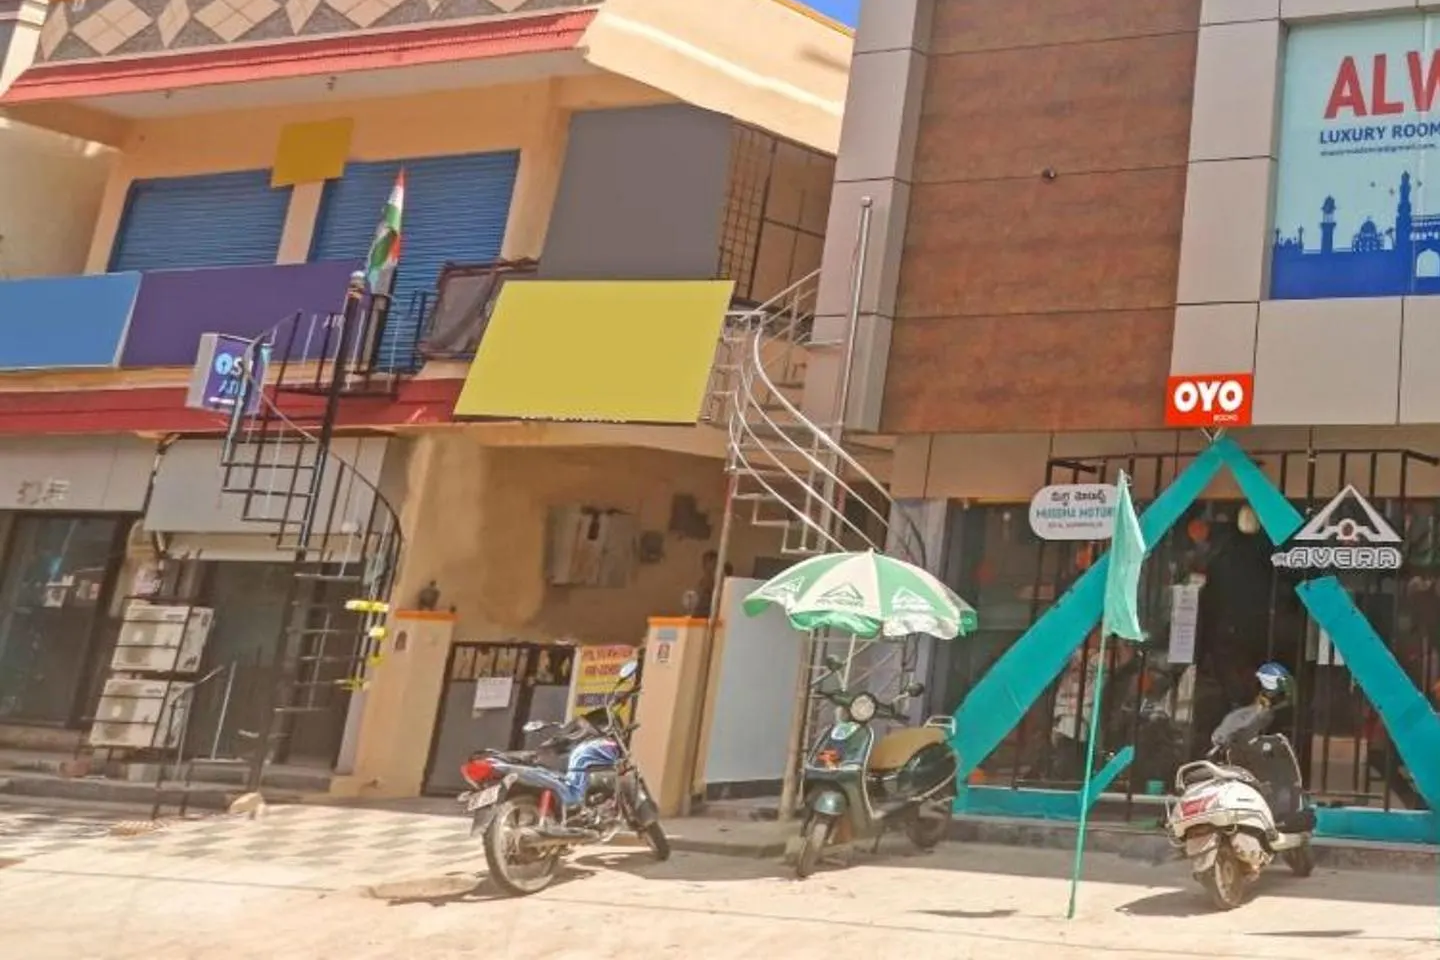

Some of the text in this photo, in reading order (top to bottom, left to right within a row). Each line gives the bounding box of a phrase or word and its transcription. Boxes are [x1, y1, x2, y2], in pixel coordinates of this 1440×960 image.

[1320, 125, 1386, 144] LUXURY
[1174, 379, 1244, 413] OYO
[1289, 547, 1403, 569] AVERA
